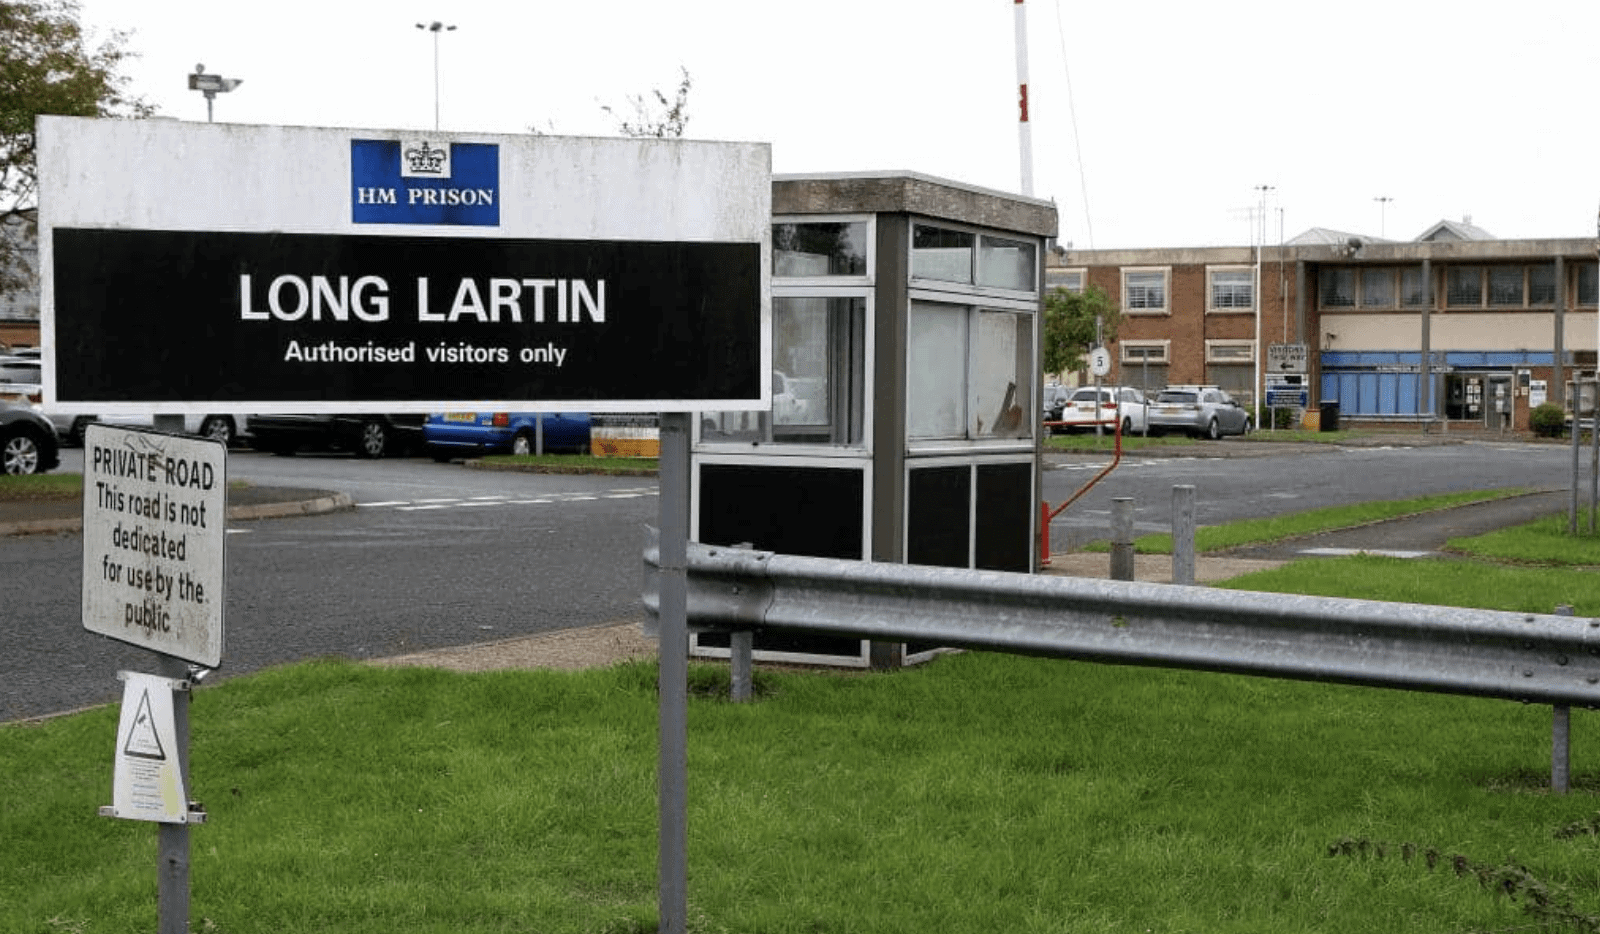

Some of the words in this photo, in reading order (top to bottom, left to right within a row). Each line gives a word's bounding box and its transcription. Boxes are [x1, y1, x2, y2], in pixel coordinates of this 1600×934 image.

[357, 187, 397, 204] HM
[408, 188, 493, 206] PRISON
[240, 274, 389, 322] LONG
[418, 276, 605, 323] LARTIN
[284, 340, 415, 363] Authorised
[426, 341, 509, 363] visitors
[520, 342, 567, 367] only
[1097, 356, 1104, 367] 5
[94, 446, 157, 482] PRIVATE
[165, 457, 214, 491] ROAD
[96, 481, 124, 513] This
[129, 492, 160, 519] road
[164, 495, 176, 522] is
[181, 500, 206, 528] not
[113, 521, 186, 561] dedicated
[103, 554, 122, 583] for
[127, 567, 153, 588] use
[156, 566, 174, 601] by
[179, 572, 204, 604] the
[125, 601, 170, 633] public
